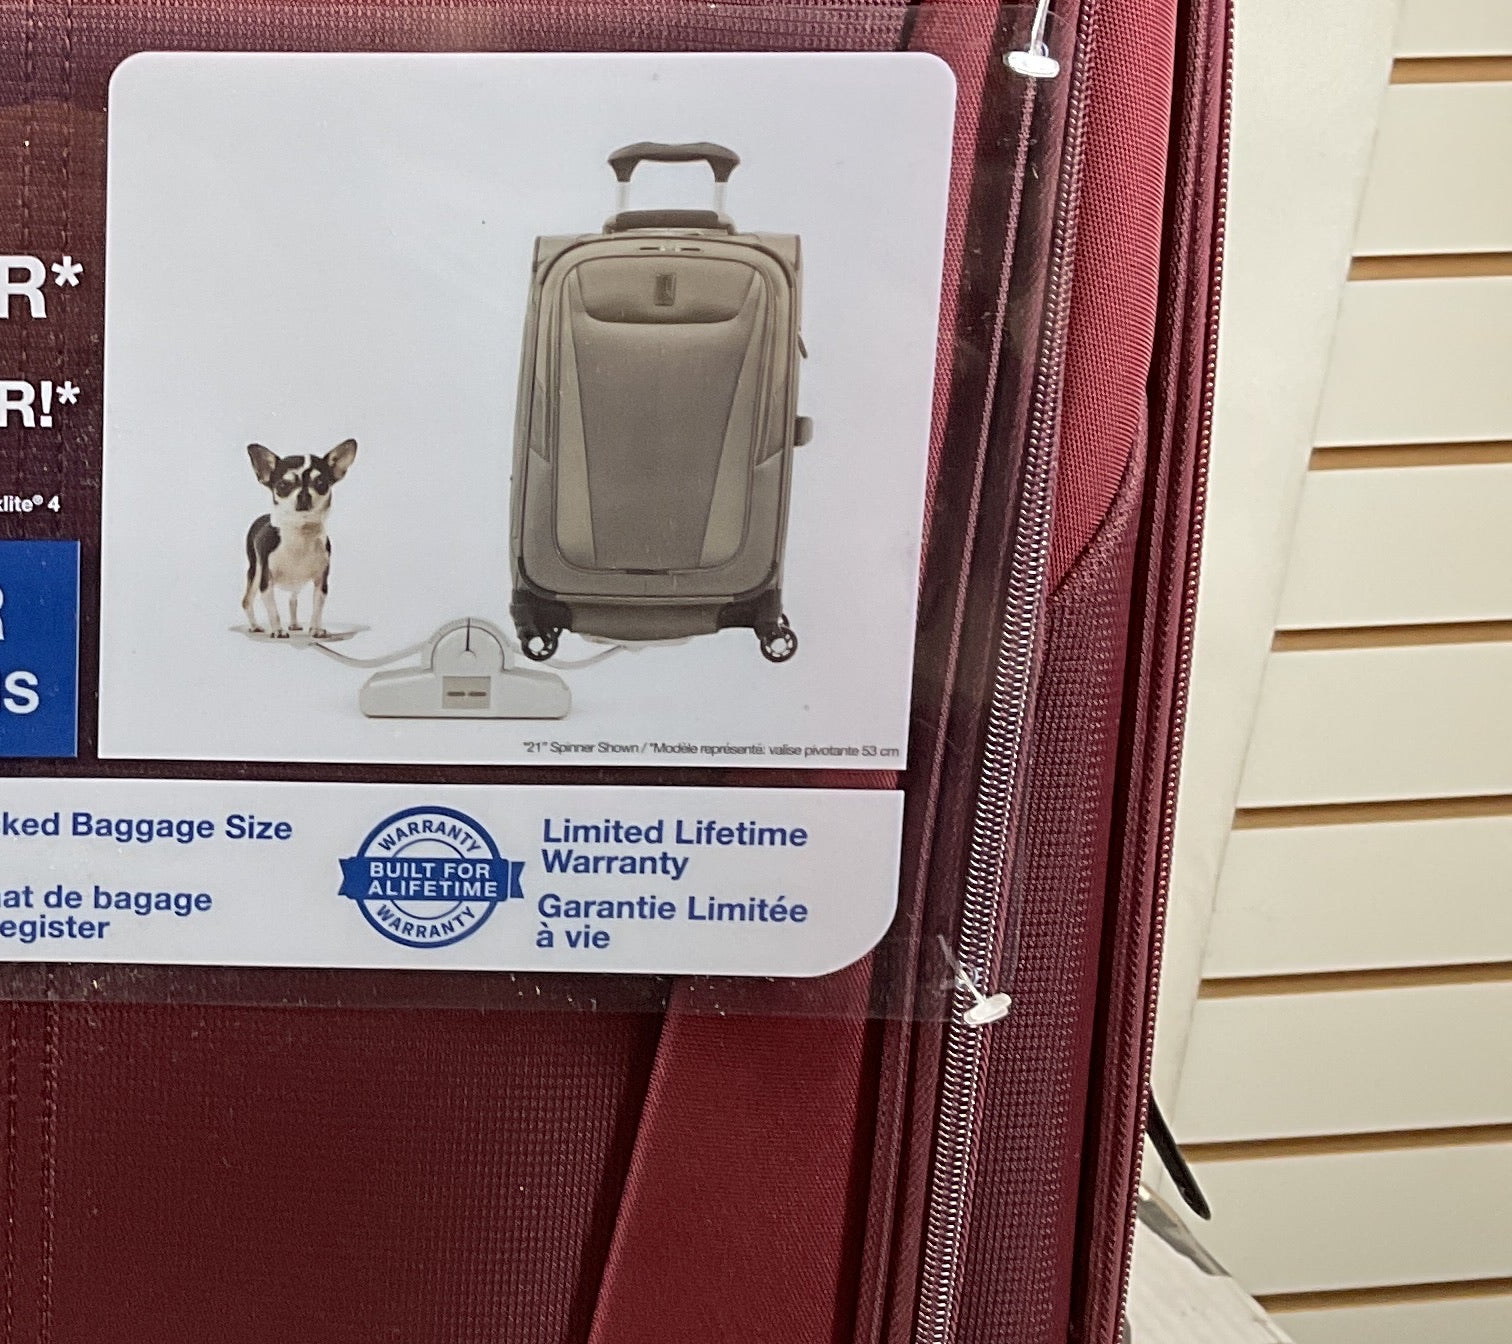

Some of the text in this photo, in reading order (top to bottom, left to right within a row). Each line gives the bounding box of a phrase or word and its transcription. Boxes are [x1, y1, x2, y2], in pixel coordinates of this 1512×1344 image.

[47, 498, 60, 512] 4
[550, 742, 594, 754] Spinner
[598, 742, 638, 753] Shown
[769, 744, 801, 755] valise
[805, 745, 859, 757] pivotante
[862, 746, 877, 756] 53
[880, 748, 899, 756] cm
[72, 812, 215, 844] Baggage
[225, 814, 293, 840] Size
[378, 820, 481, 853] WARRANTY
[544, 819, 808, 846] Limited Lifetime
[370, 862, 490, 879] BUILT FOR
[541, 849, 689, 880] Warranty
[44, 885, 82, 908] de
[94, 886, 212, 916] bagage
[538, 893, 808, 922] Garantie Limitée
[377, 904, 475, 938] WARRANTY
[536, 922, 610, 949] à vie
